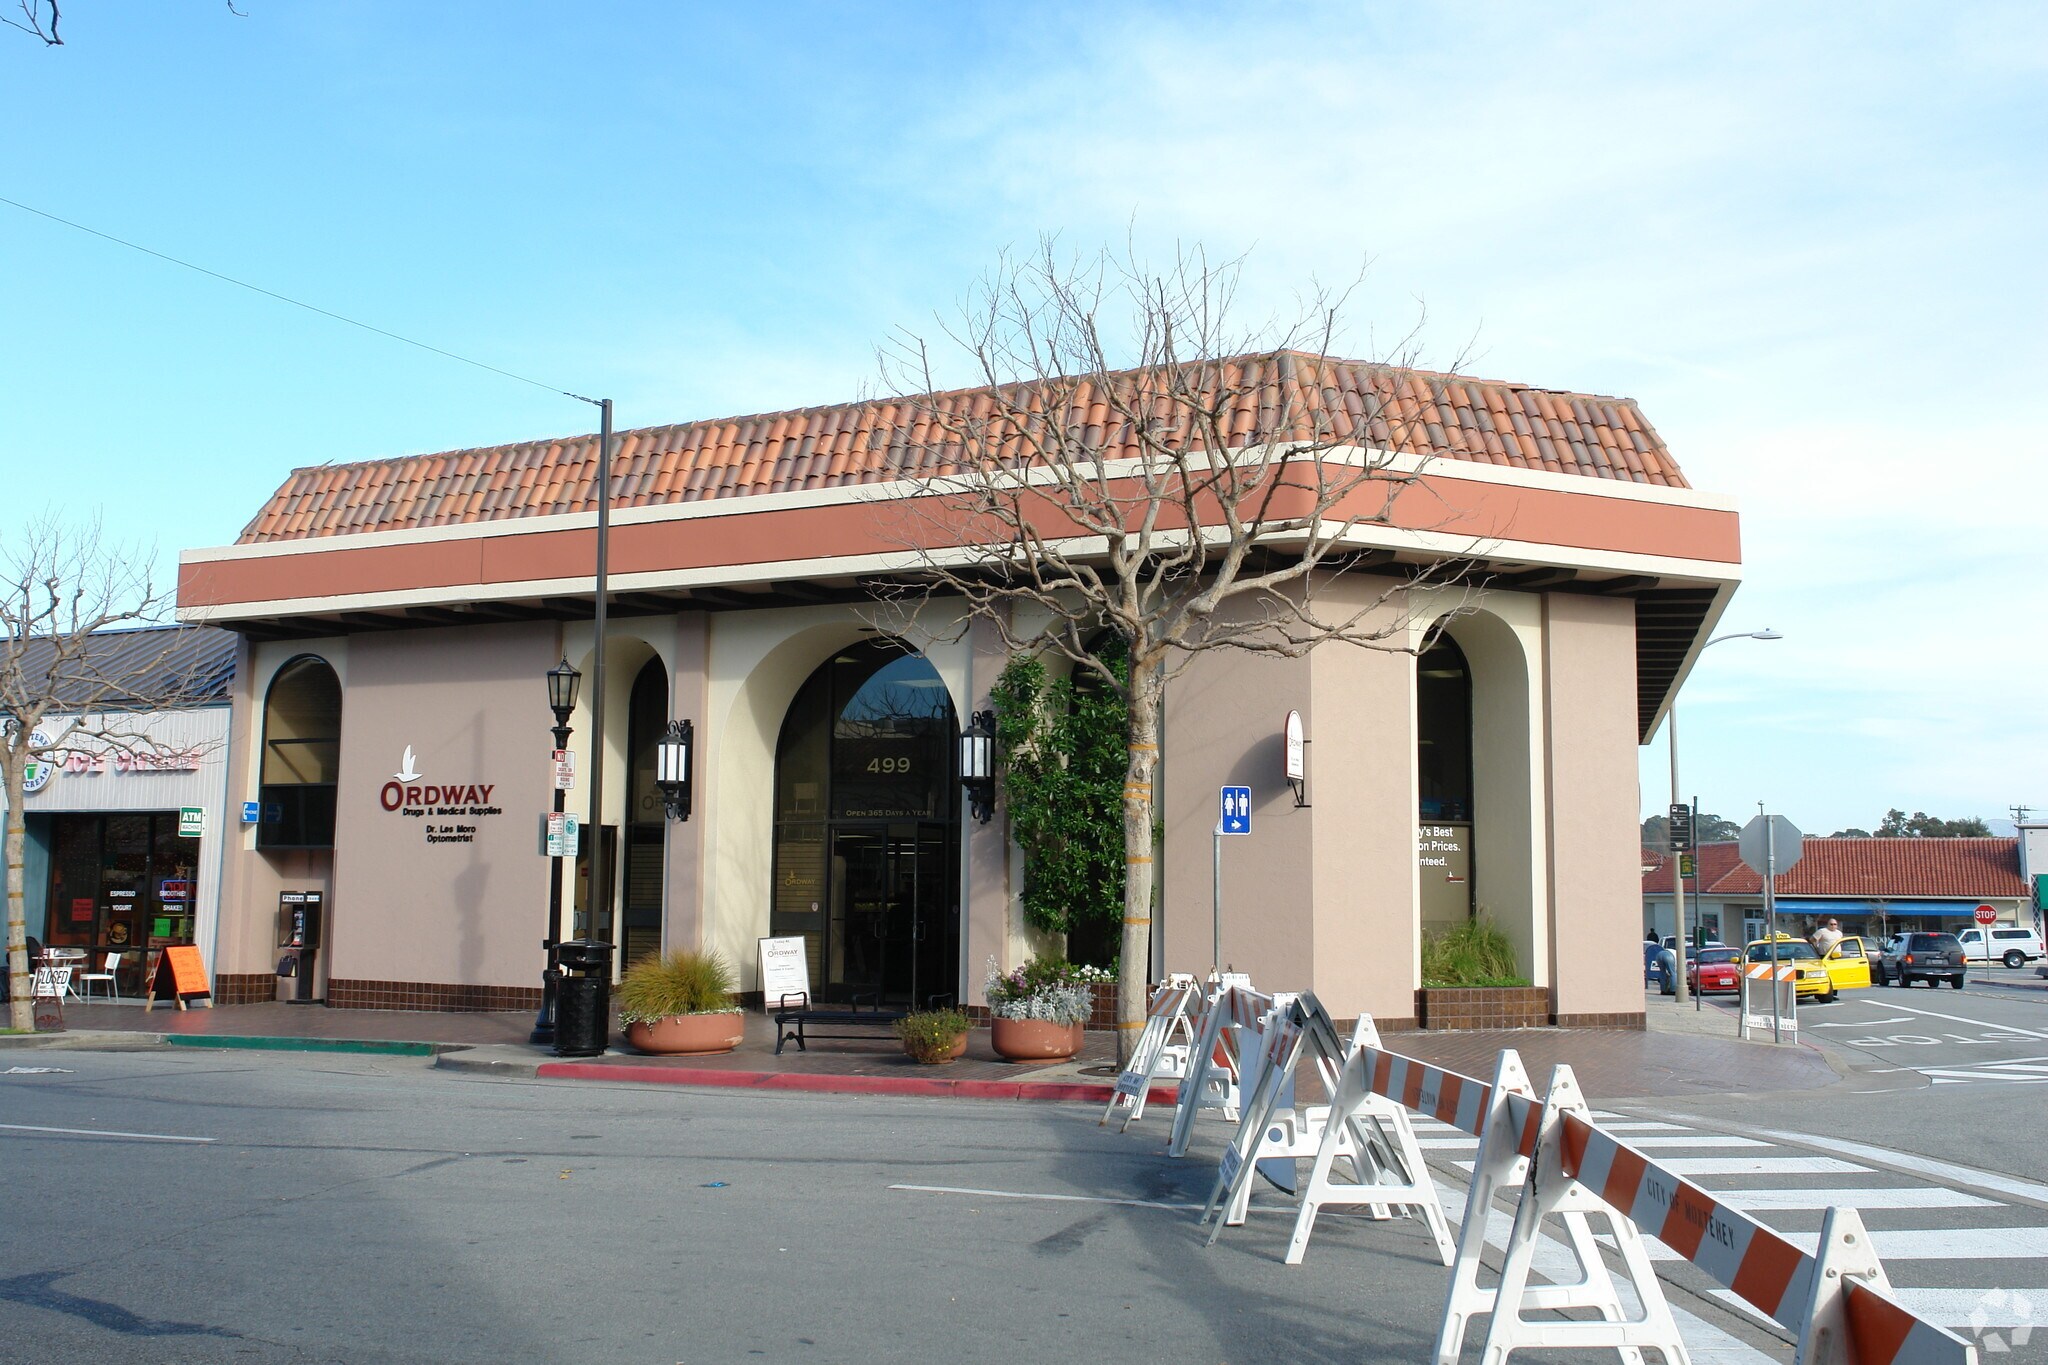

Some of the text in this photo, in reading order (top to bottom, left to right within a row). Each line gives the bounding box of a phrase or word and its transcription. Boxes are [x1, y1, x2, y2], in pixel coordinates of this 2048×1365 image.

[866, 757, 911, 774] 499
[25, 767, 50, 788] CREAM
[381, 781, 495, 812] ORDWAY
[182, 811, 202, 822] ATM
[402, 807, 425, 818] Drugs
[437, 807, 466, 816] Medical
[469, 806, 502, 816] Supplies
[426, 825, 476, 833] Dr. Les Moro
[1433, 827, 1454, 837] Best
[427, 834, 473, 844] Optometrist
[1431, 841, 1461, 852] Prices.
[1975, 910, 1996, 919] STOP
[768, 950, 798, 958] ORDWAY
[37, 970, 69, 985] CLOSED
[1847, 1032, 2042, 1047] STOP
[1647, 1177, 1666, 1206] CITY
